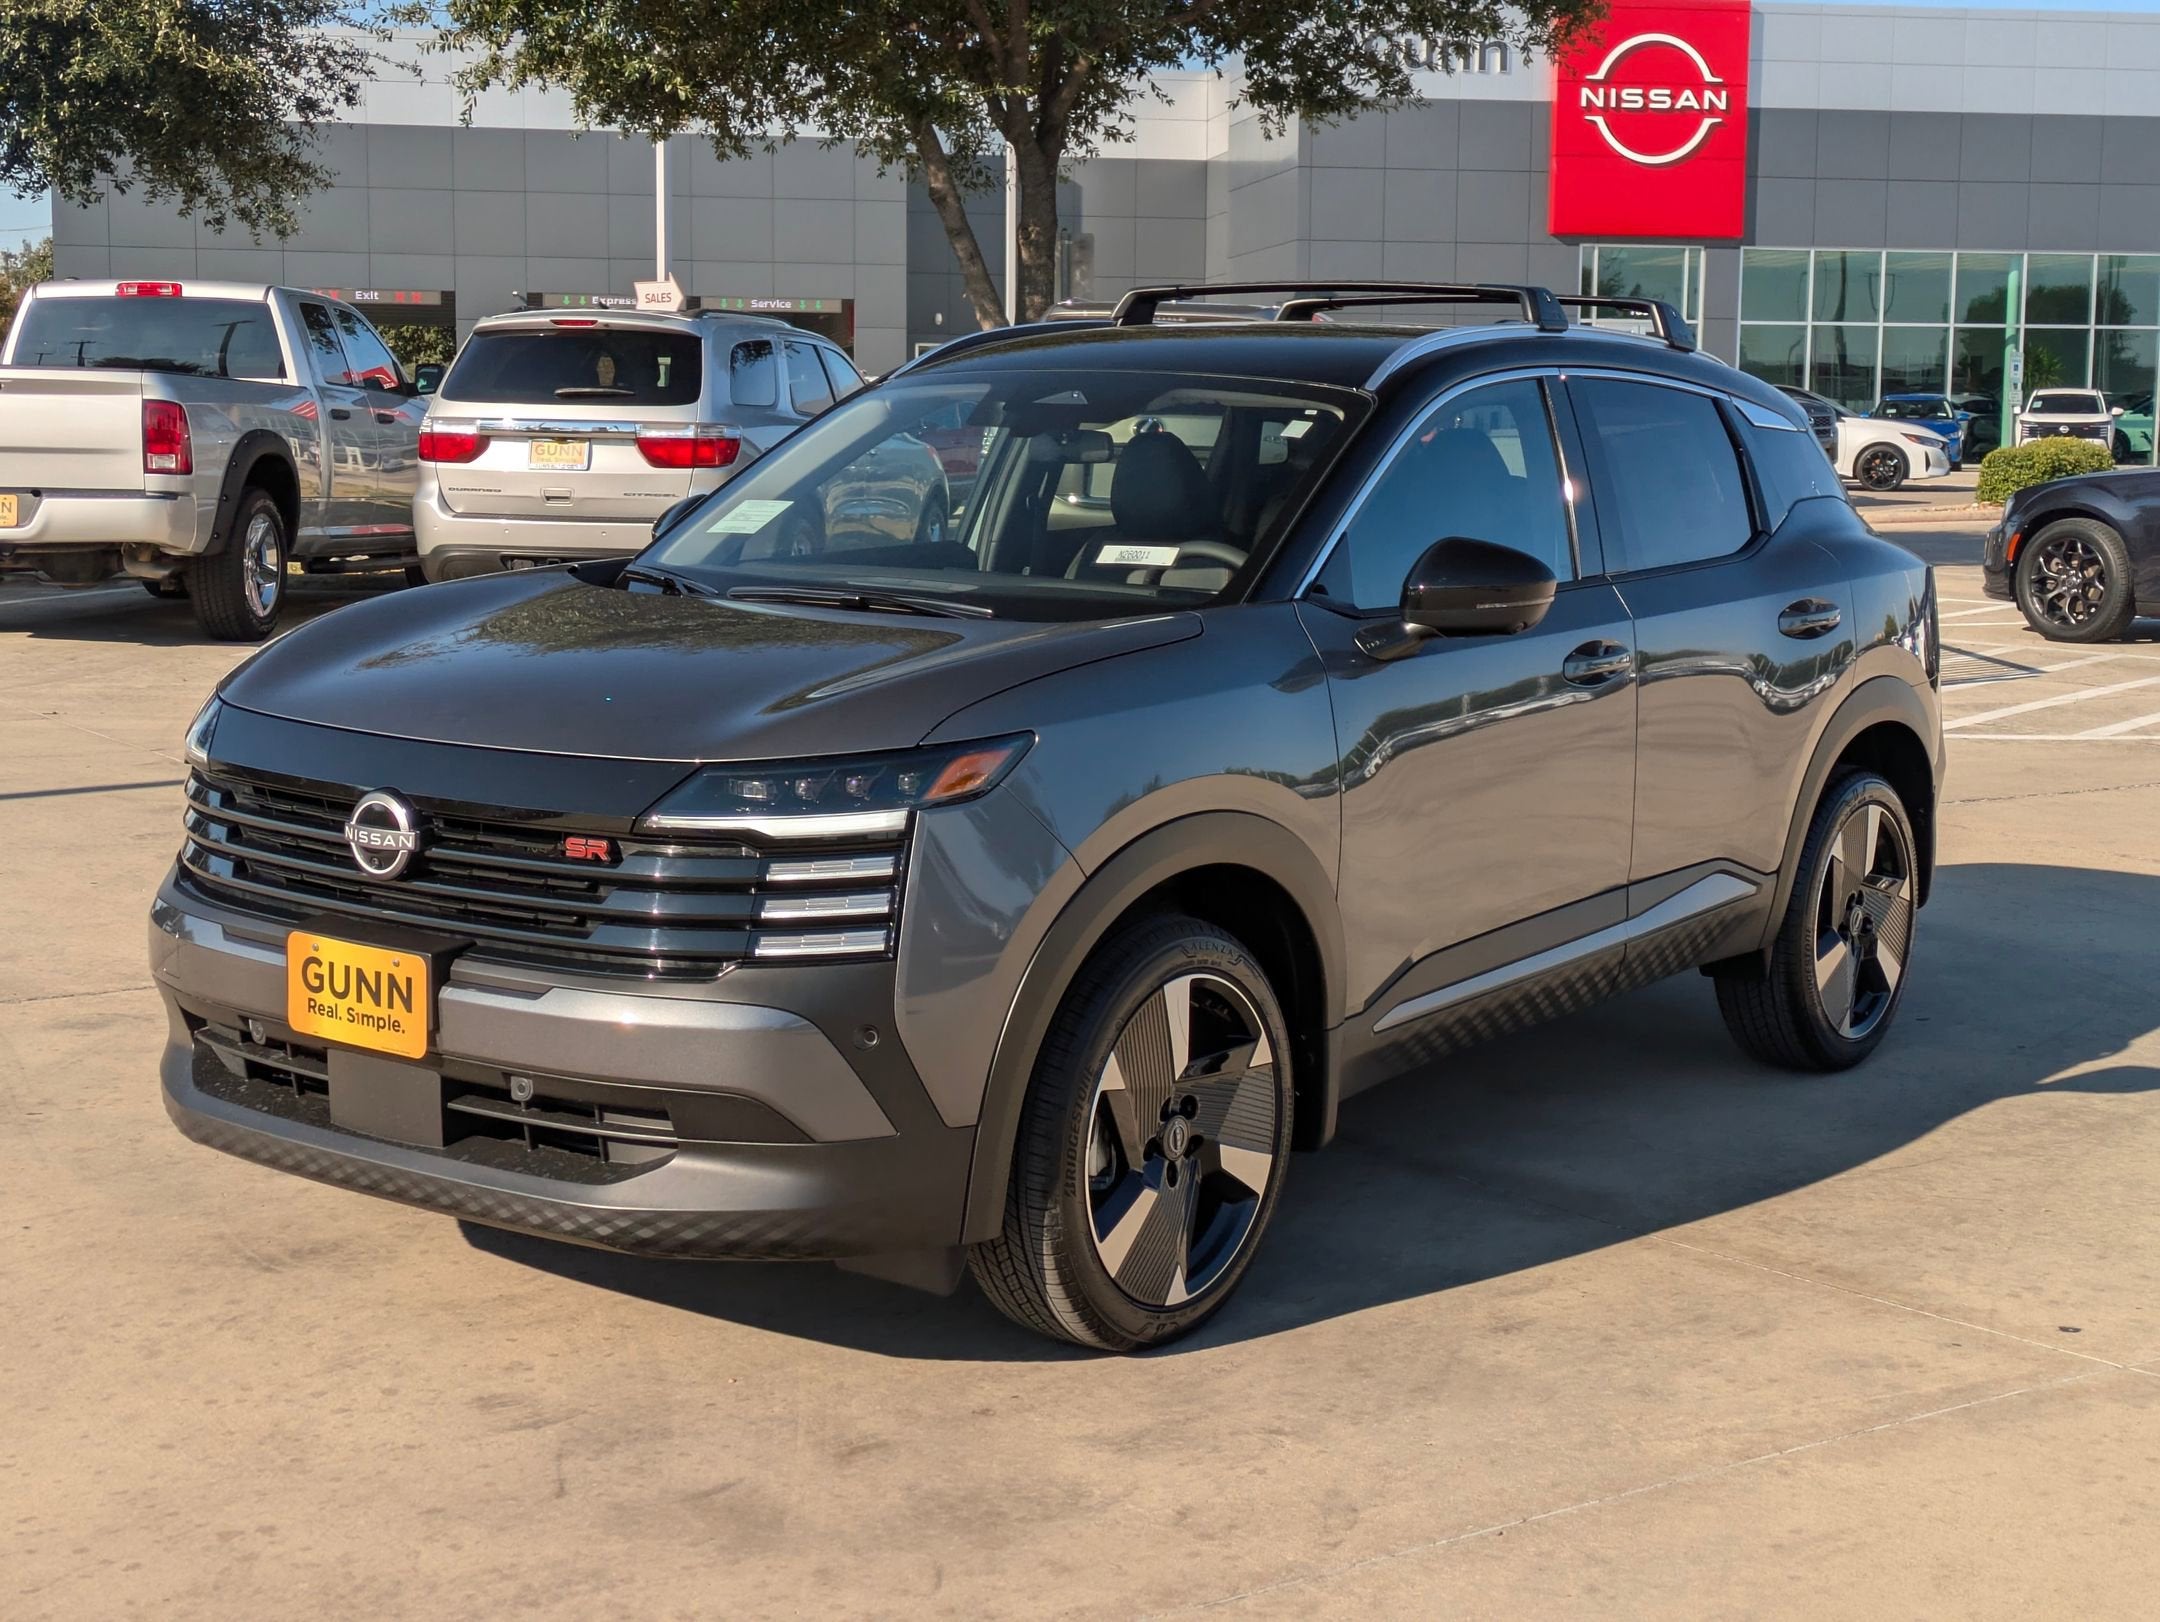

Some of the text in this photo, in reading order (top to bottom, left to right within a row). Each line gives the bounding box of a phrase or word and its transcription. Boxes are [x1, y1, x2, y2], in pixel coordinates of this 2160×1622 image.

[1580, 87, 1727, 110] NISSAN
[355, 290, 379, 300] Exit
[645, 292, 672, 304] SALES
[750, 299, 792, 309] Service
[534, 444, 583, 457] GUNN
[345, 825, 413, 848] NISSAN
[565, 837, 611, 862] SR
[301, 956, 413, 1014] GUNN
[307, 997, 342, 1021] Real.
